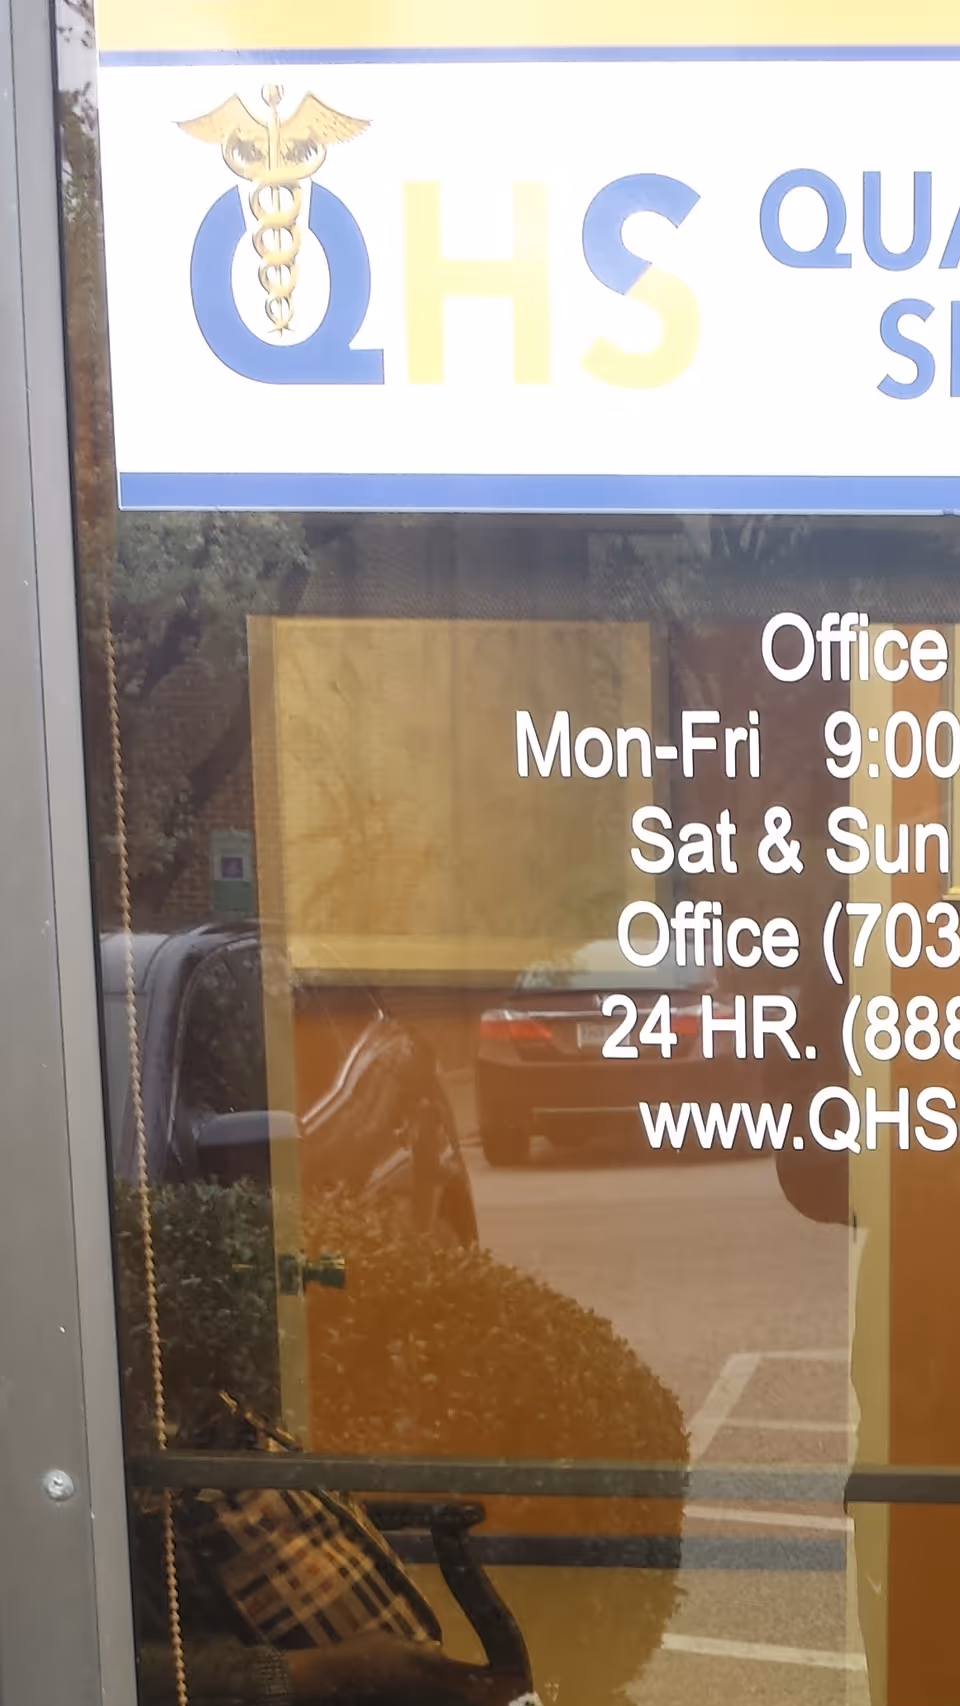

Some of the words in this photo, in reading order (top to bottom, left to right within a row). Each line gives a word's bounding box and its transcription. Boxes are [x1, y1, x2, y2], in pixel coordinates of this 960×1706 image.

[190, 170, 702, 388] QHS
[761, 612, 948, 682] Office
[516, 710, 760, 778] Mon-Fri
[630, 805, 738, 874] Sat
[758, 806, 804, 874] &
[826, 806, 949, 874] Sun
[617, 900, 799, 968] Office
[602, 994, 678, 1058] 24
[701, 995, 816, 1059] HR.
